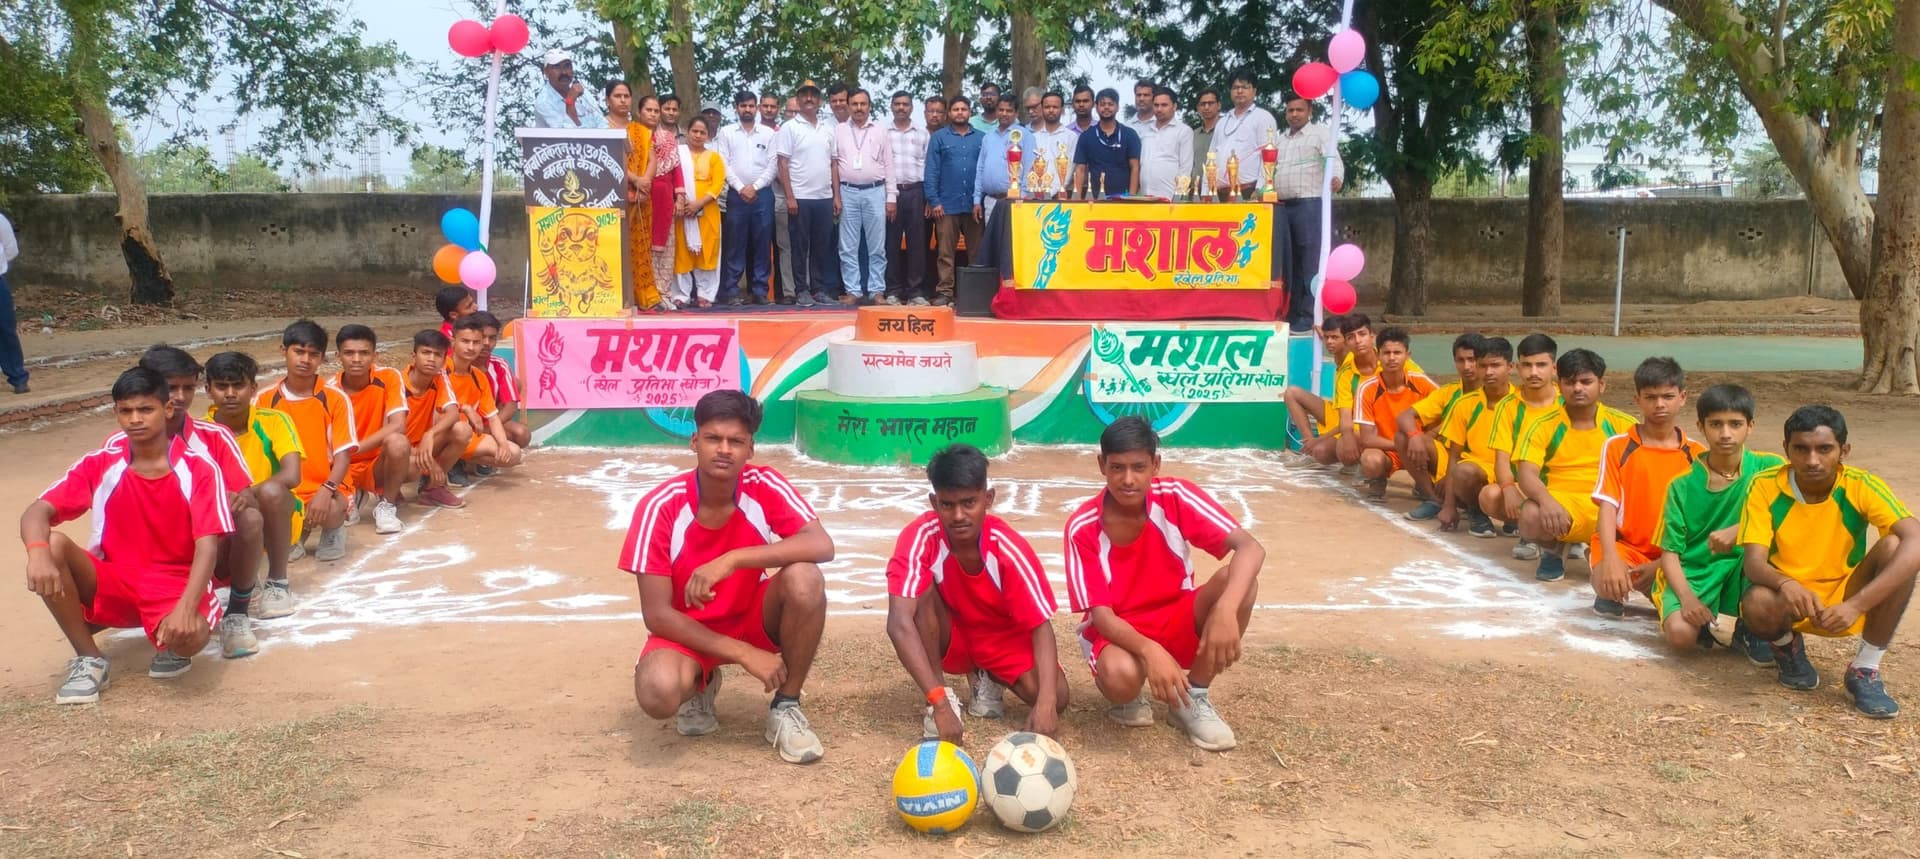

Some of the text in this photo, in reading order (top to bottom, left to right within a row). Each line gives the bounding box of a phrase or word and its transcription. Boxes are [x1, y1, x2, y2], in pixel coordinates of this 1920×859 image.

[1085, 220, 1240, 281] मशाल
[878, 314, 936, 336] जय हिन्द
[586, 327, 735, 374] मशाल
[862, 350, 953, 371] सत्यमेव जयते
[1125, 329, 1275, 371] मशाल
[626, 375, 679, 395] प्रतिभा
[1199, 367, 1256, 390] प्रतिभा
[1255, 370, 1285, 390] खोज
[837, 409, 979, 445] मेरा भारत महान
[901, 794, 962, 814] NIVIA
